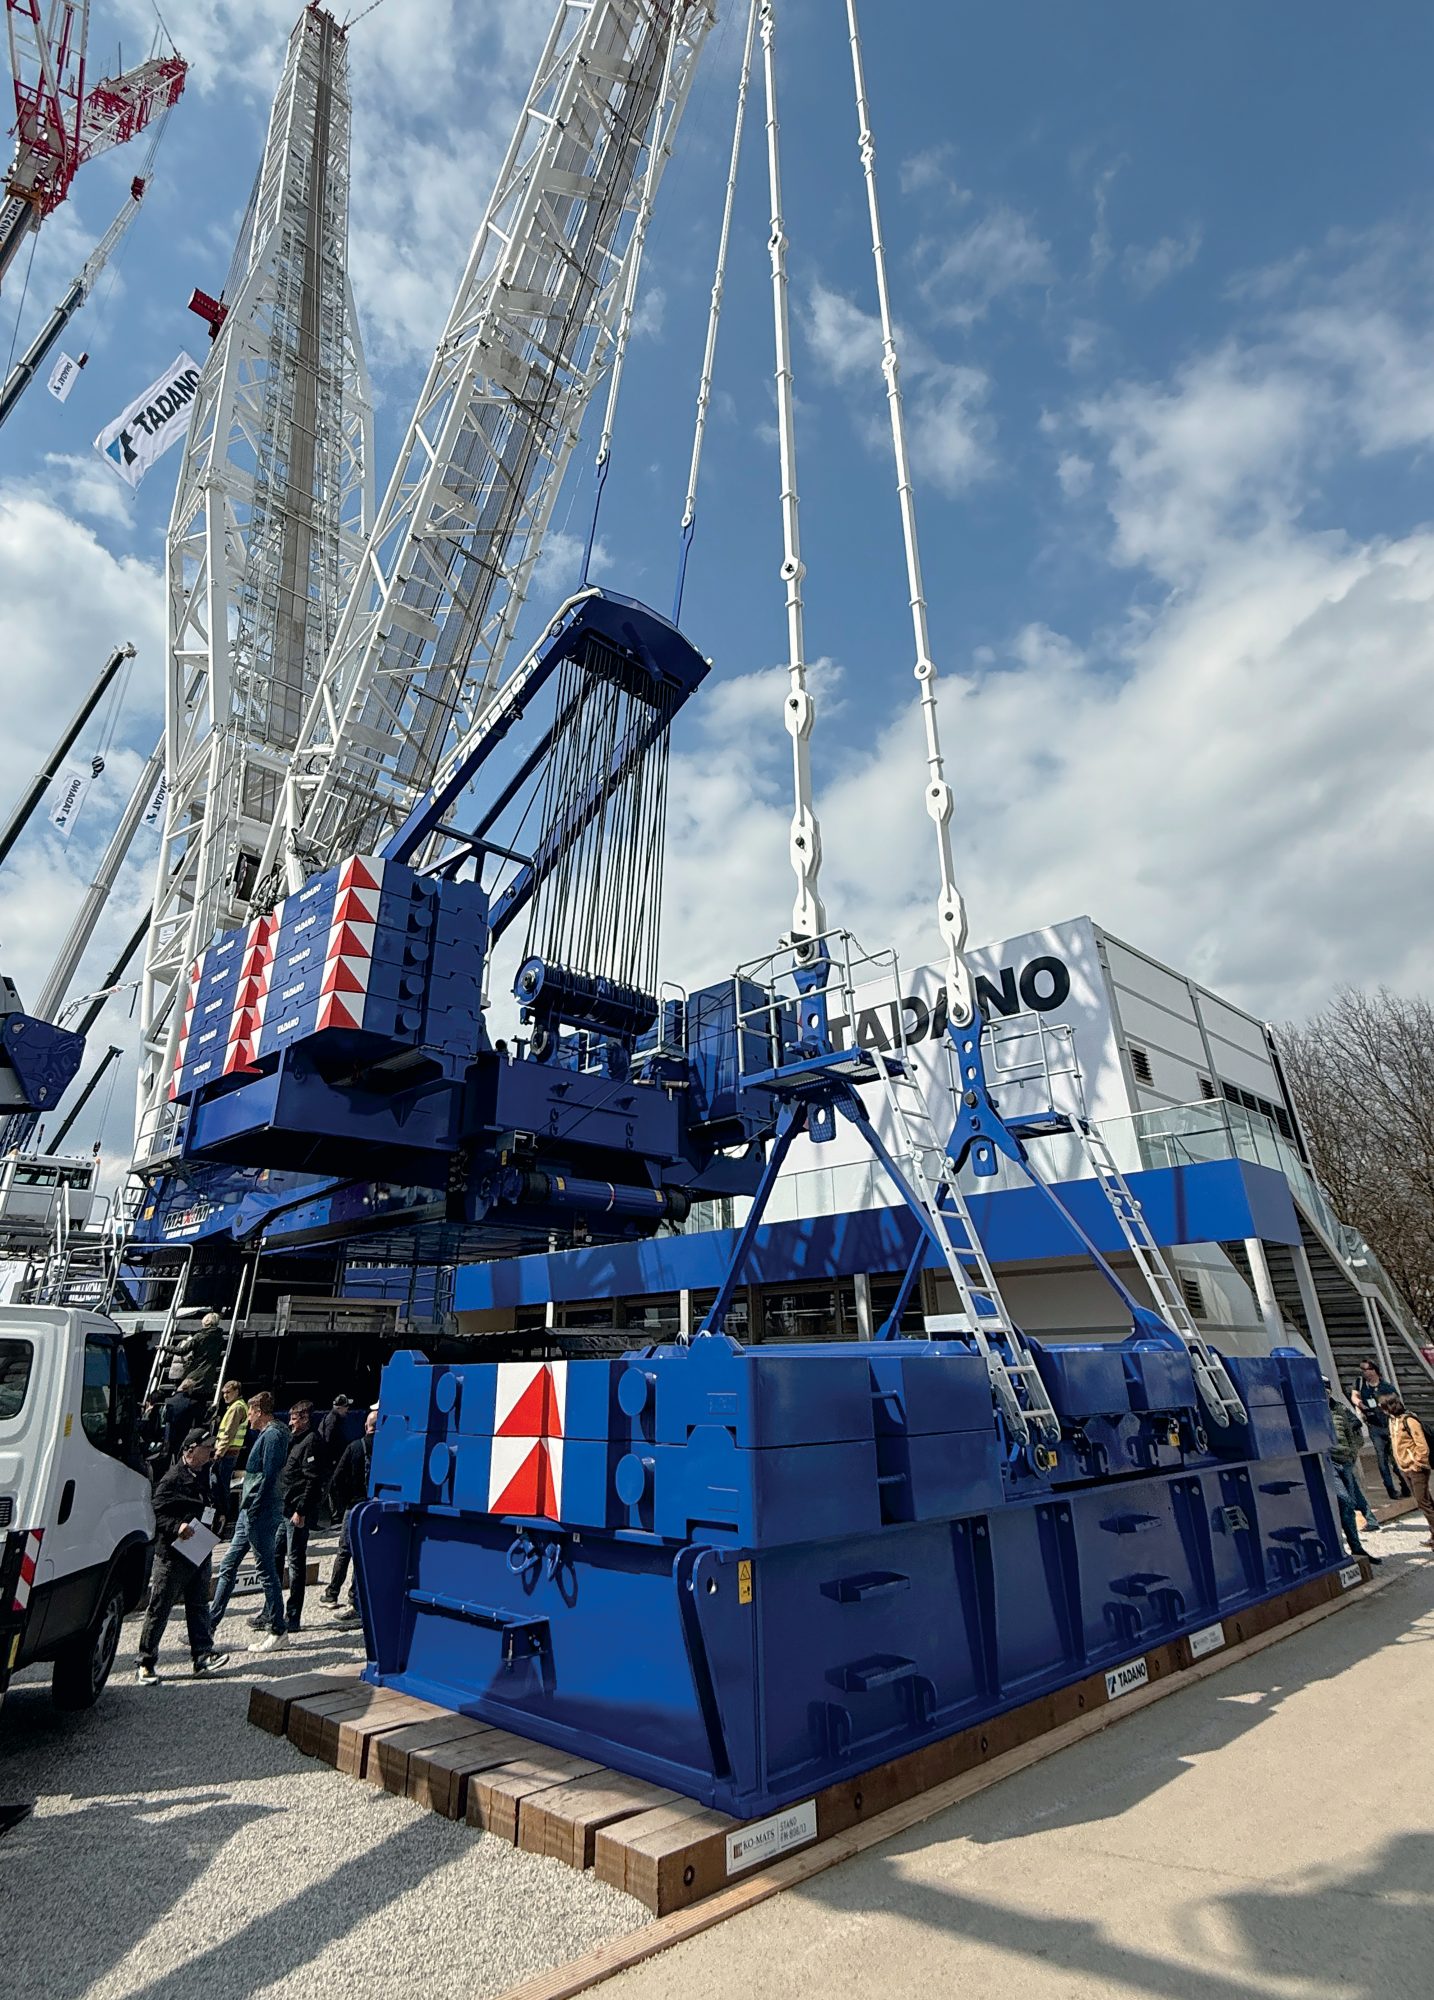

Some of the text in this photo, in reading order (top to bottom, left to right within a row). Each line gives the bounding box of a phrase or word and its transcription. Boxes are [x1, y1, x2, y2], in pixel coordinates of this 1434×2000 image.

[132, 368, 200, 436] TADANO
[433, 763, 458, 794] CC
[1117, 1662, 1146, 1688] TADANO
